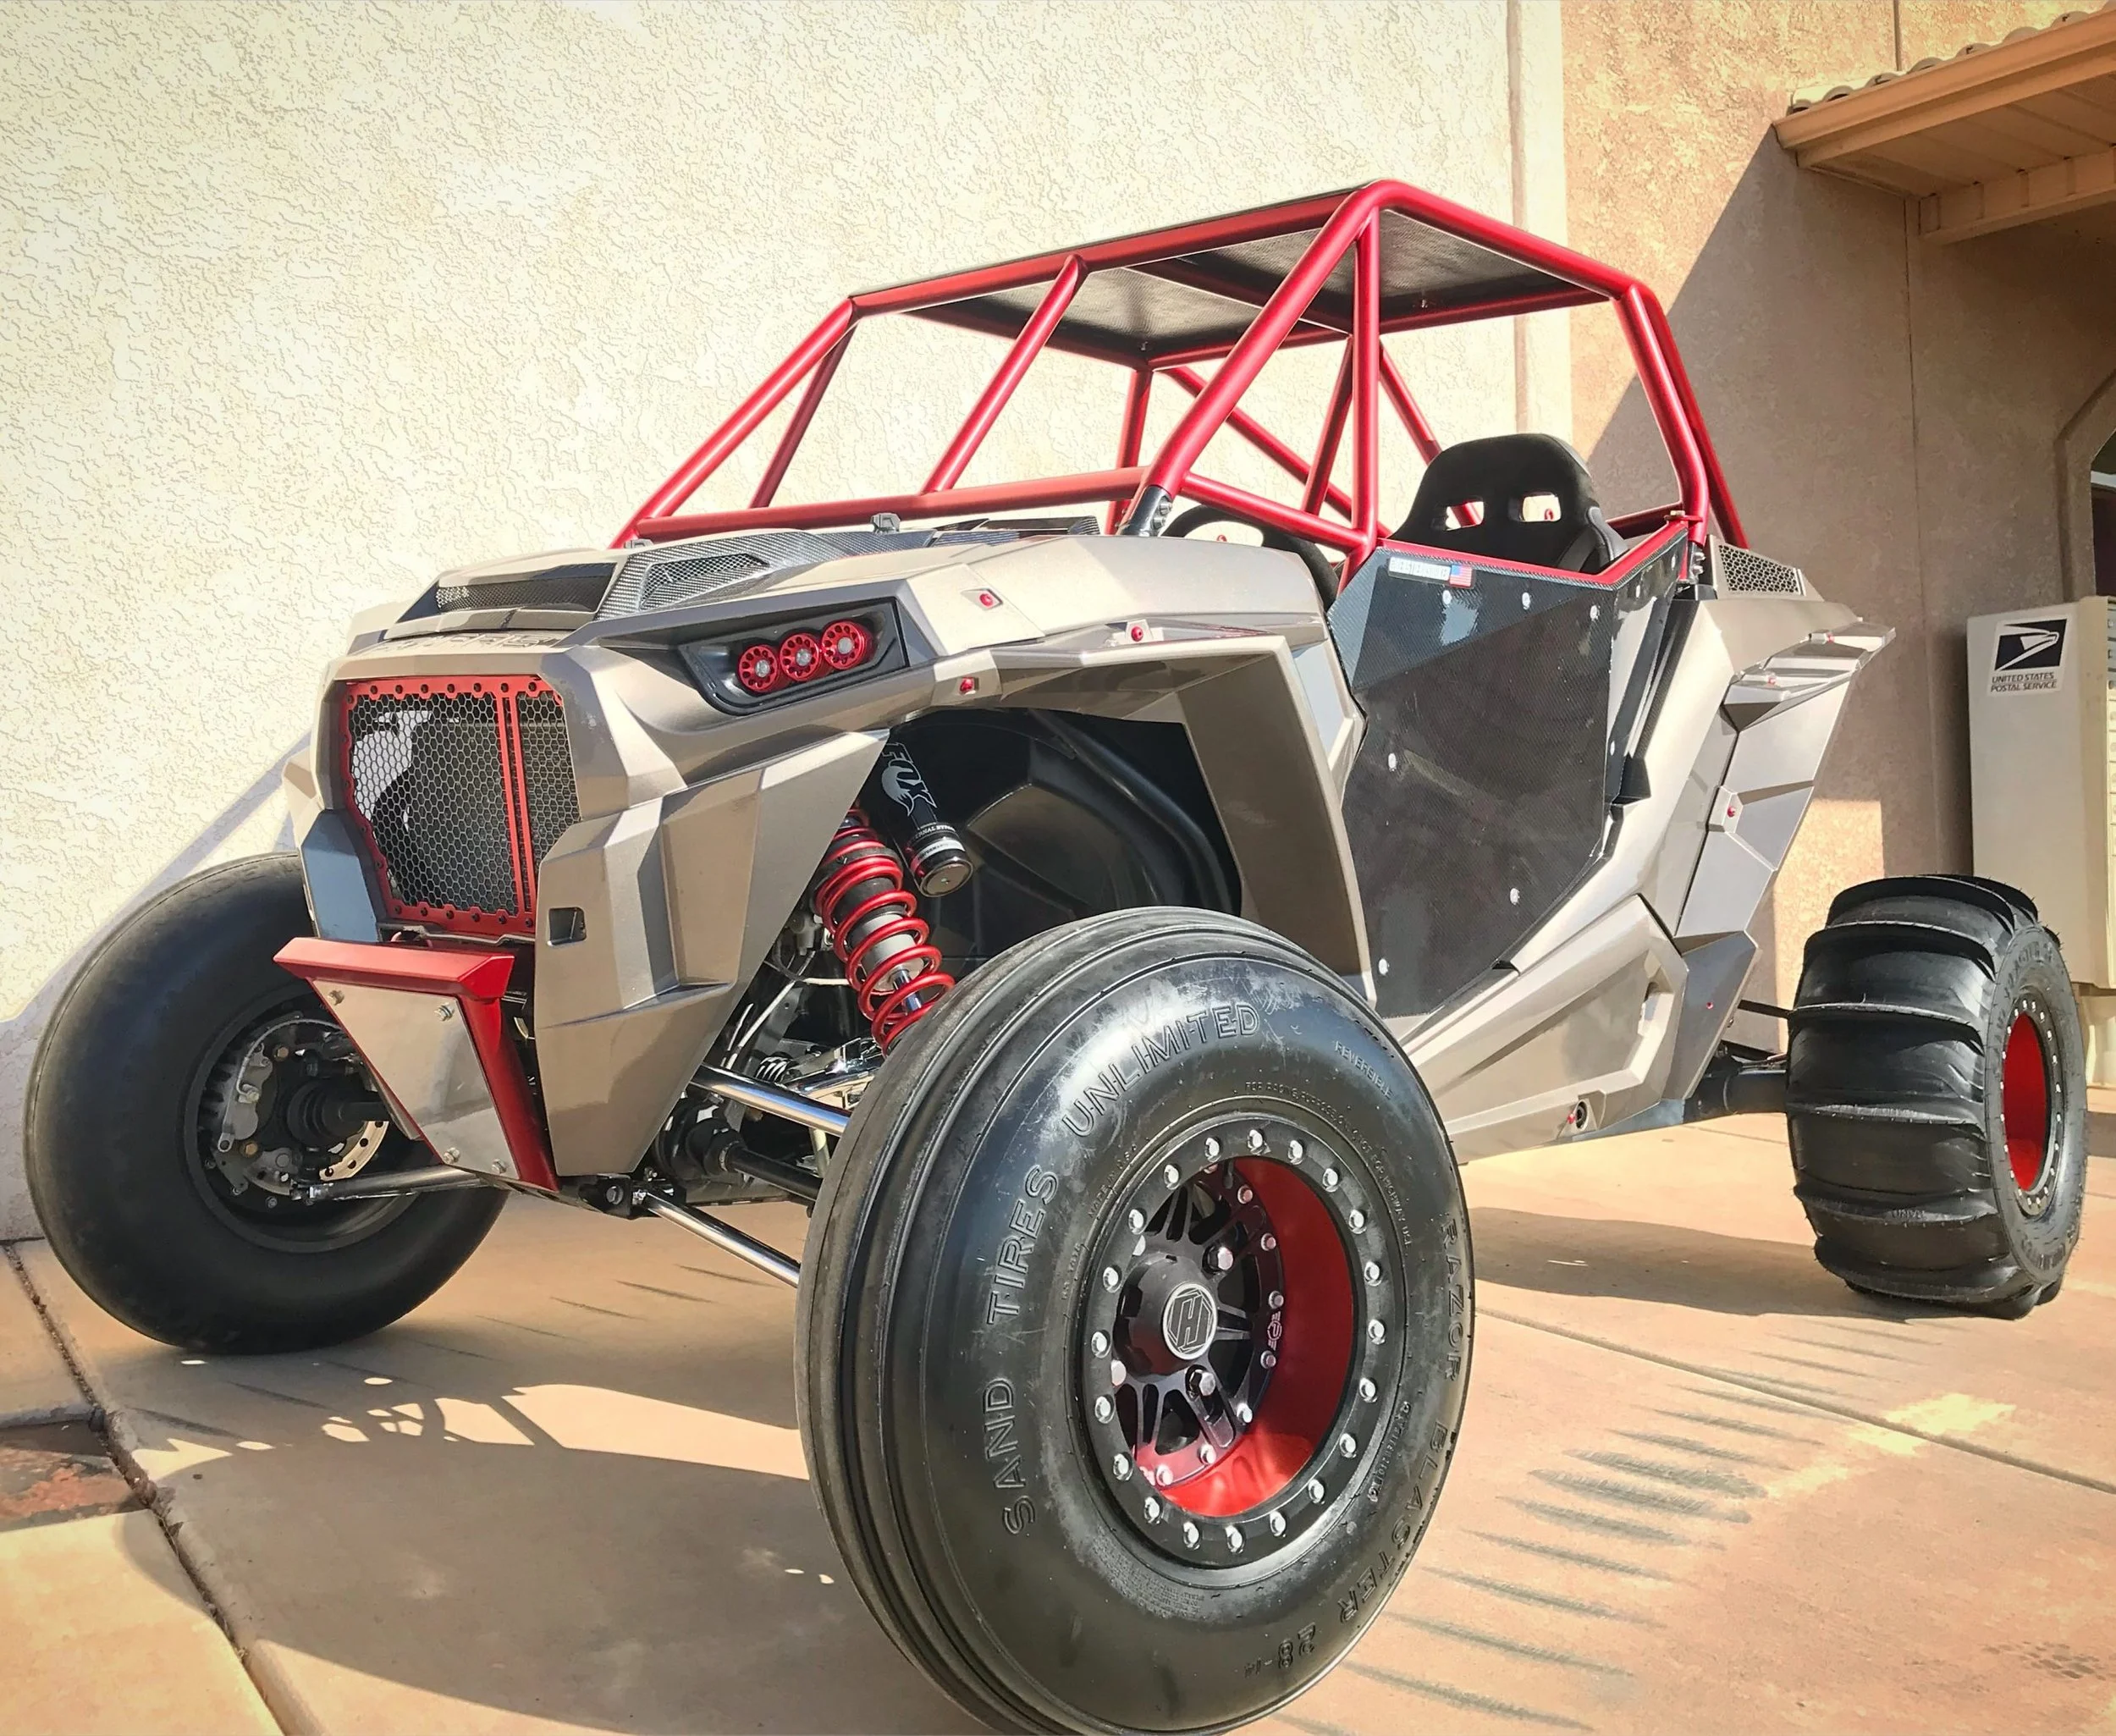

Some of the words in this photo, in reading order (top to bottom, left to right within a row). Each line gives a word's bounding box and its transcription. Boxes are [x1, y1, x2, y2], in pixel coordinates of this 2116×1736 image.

[1991, 684, 2020, 692] POSTAL
[2023, 680, 2057, 691] SERVICE
[1992, 675, 2023, 683] UNITED
[2025, 672, 2054, 681] STATES
[882, 742, 937, 816] FOX
[1061, 1003, 1262, 1140] UNLIMITED
[1335, 1040, 1394, 1099] REVERSIBLE
[987, 1164, 1059, 1325] TIRES
[1441, 1219, 1464, 1381] RAZOR
[983, 1377, 1035, 1535] SAND
[1339, 1422, 1448, 1624] BLASTER
